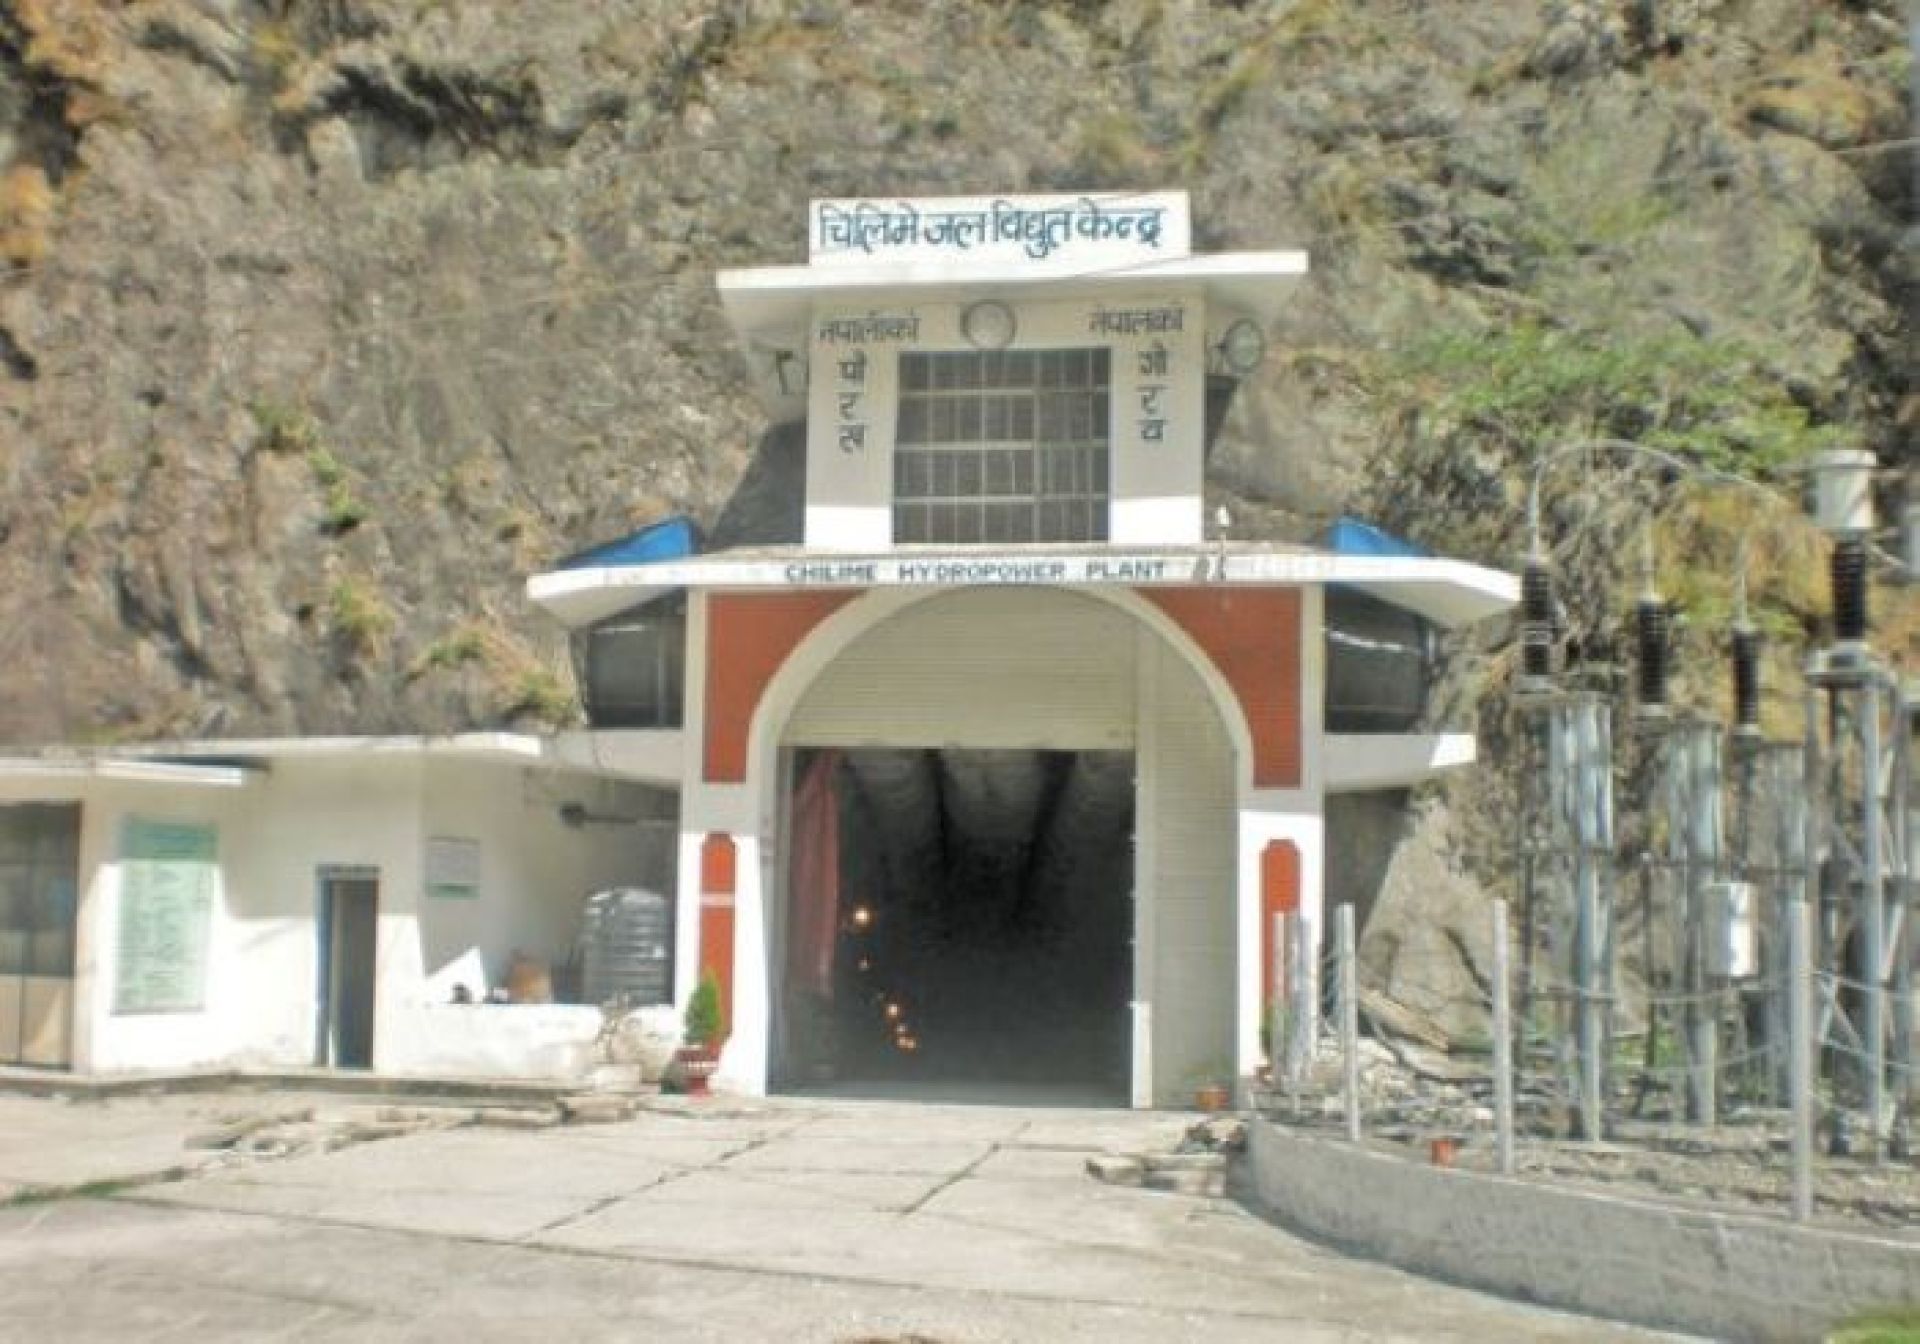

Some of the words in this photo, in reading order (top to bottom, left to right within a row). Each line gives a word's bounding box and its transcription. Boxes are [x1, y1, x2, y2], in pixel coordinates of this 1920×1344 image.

[924, 213, 986, 249] जल
[786, 563, 874, 581] CHILIME
[899, 562, 1064, 580] HYDROPOWER
[1085, 561, 1164, 578] PLANT
